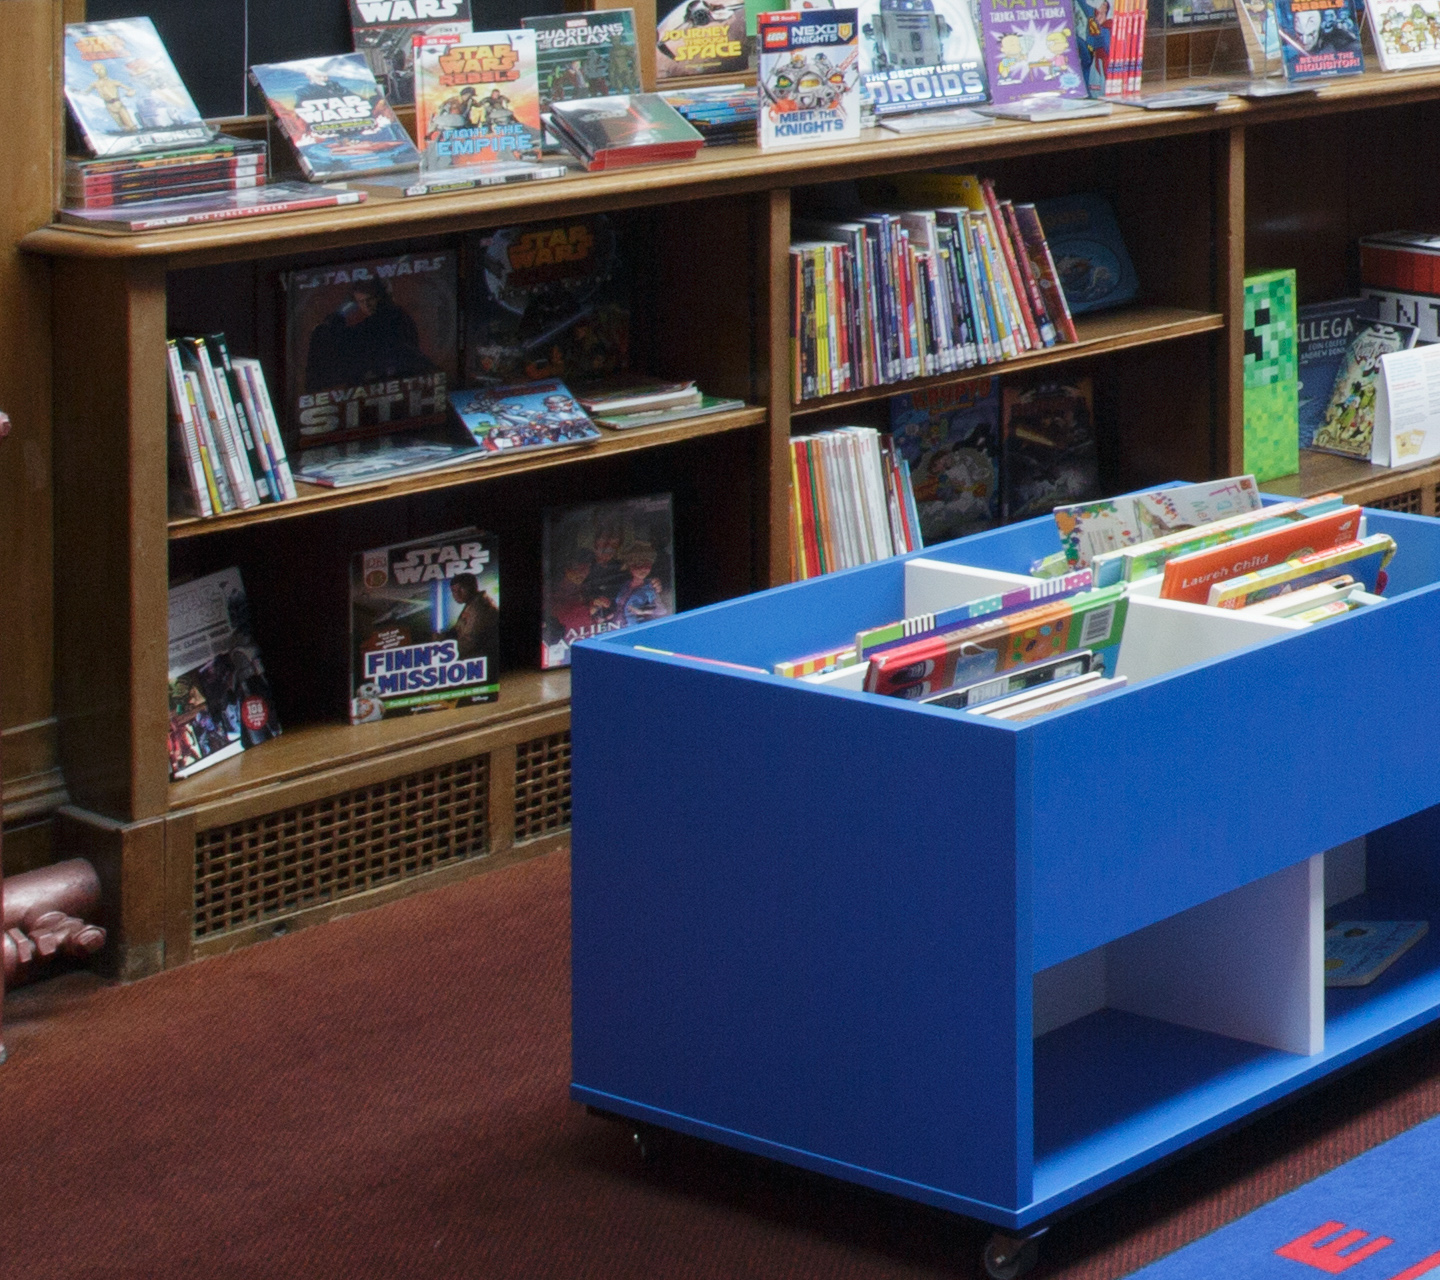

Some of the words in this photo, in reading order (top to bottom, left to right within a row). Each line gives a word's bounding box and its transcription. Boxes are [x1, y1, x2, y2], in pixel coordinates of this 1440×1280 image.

[1291, 0, 1344, 12] REBELS
[535, 23, 624, 41] GUARDIANS
[661, 25, 731, 41] JOURNEY
[766, 30, 786, 42] LEGO
[792, 23, 838, 37] NEXO
[792, 33, 838, 44] KNIGHTS
[440, 44, 519, 61] STAR
[675, 41, 742, 62] SPACE
[440, 56, 518, 74] WARS
[865, 71, 884, 83] THE
[885, 65, 935, 80] SECRET
[937, 63, 959, 75] LIFE
[962, 61, 978, 72] OF
[439, 70, 520, 86] REBELS
[866, 72, 984, 104] DROIDS
[299, 95, 370, 112] STAR
[296, 105, 371, 124] WARS
[779, 112, 814, 124] MEET
[818, 110, 837, 120] THE
[442, 126, 488, 140] FIGHT
[495, 123, 523, 134] THE
[774, 119, 844, 138] KNIGHTS
[437, 134, 532, 156] EMPIRE
[299, 267, 374, 290] STAR
[376, 256, 446, 278] WARS
[299, 381, 400, 409] BEWARE
[403, 372, 447, 391] THE
[299, 386, 447, 435] SITH
[394, 542, 490, 568] STAR
[393, 558, 489, 585] WARS
[1182, 566, 1229, 589] Lauren
[1232, 554, 1270, 573] Child
[565, 621, 621, 638] ALIEN
[366, 643, 456, 676] FINN'S
[378, 659, 485, 693] MISSION
[1273, 1220, 1395, 1274] E
